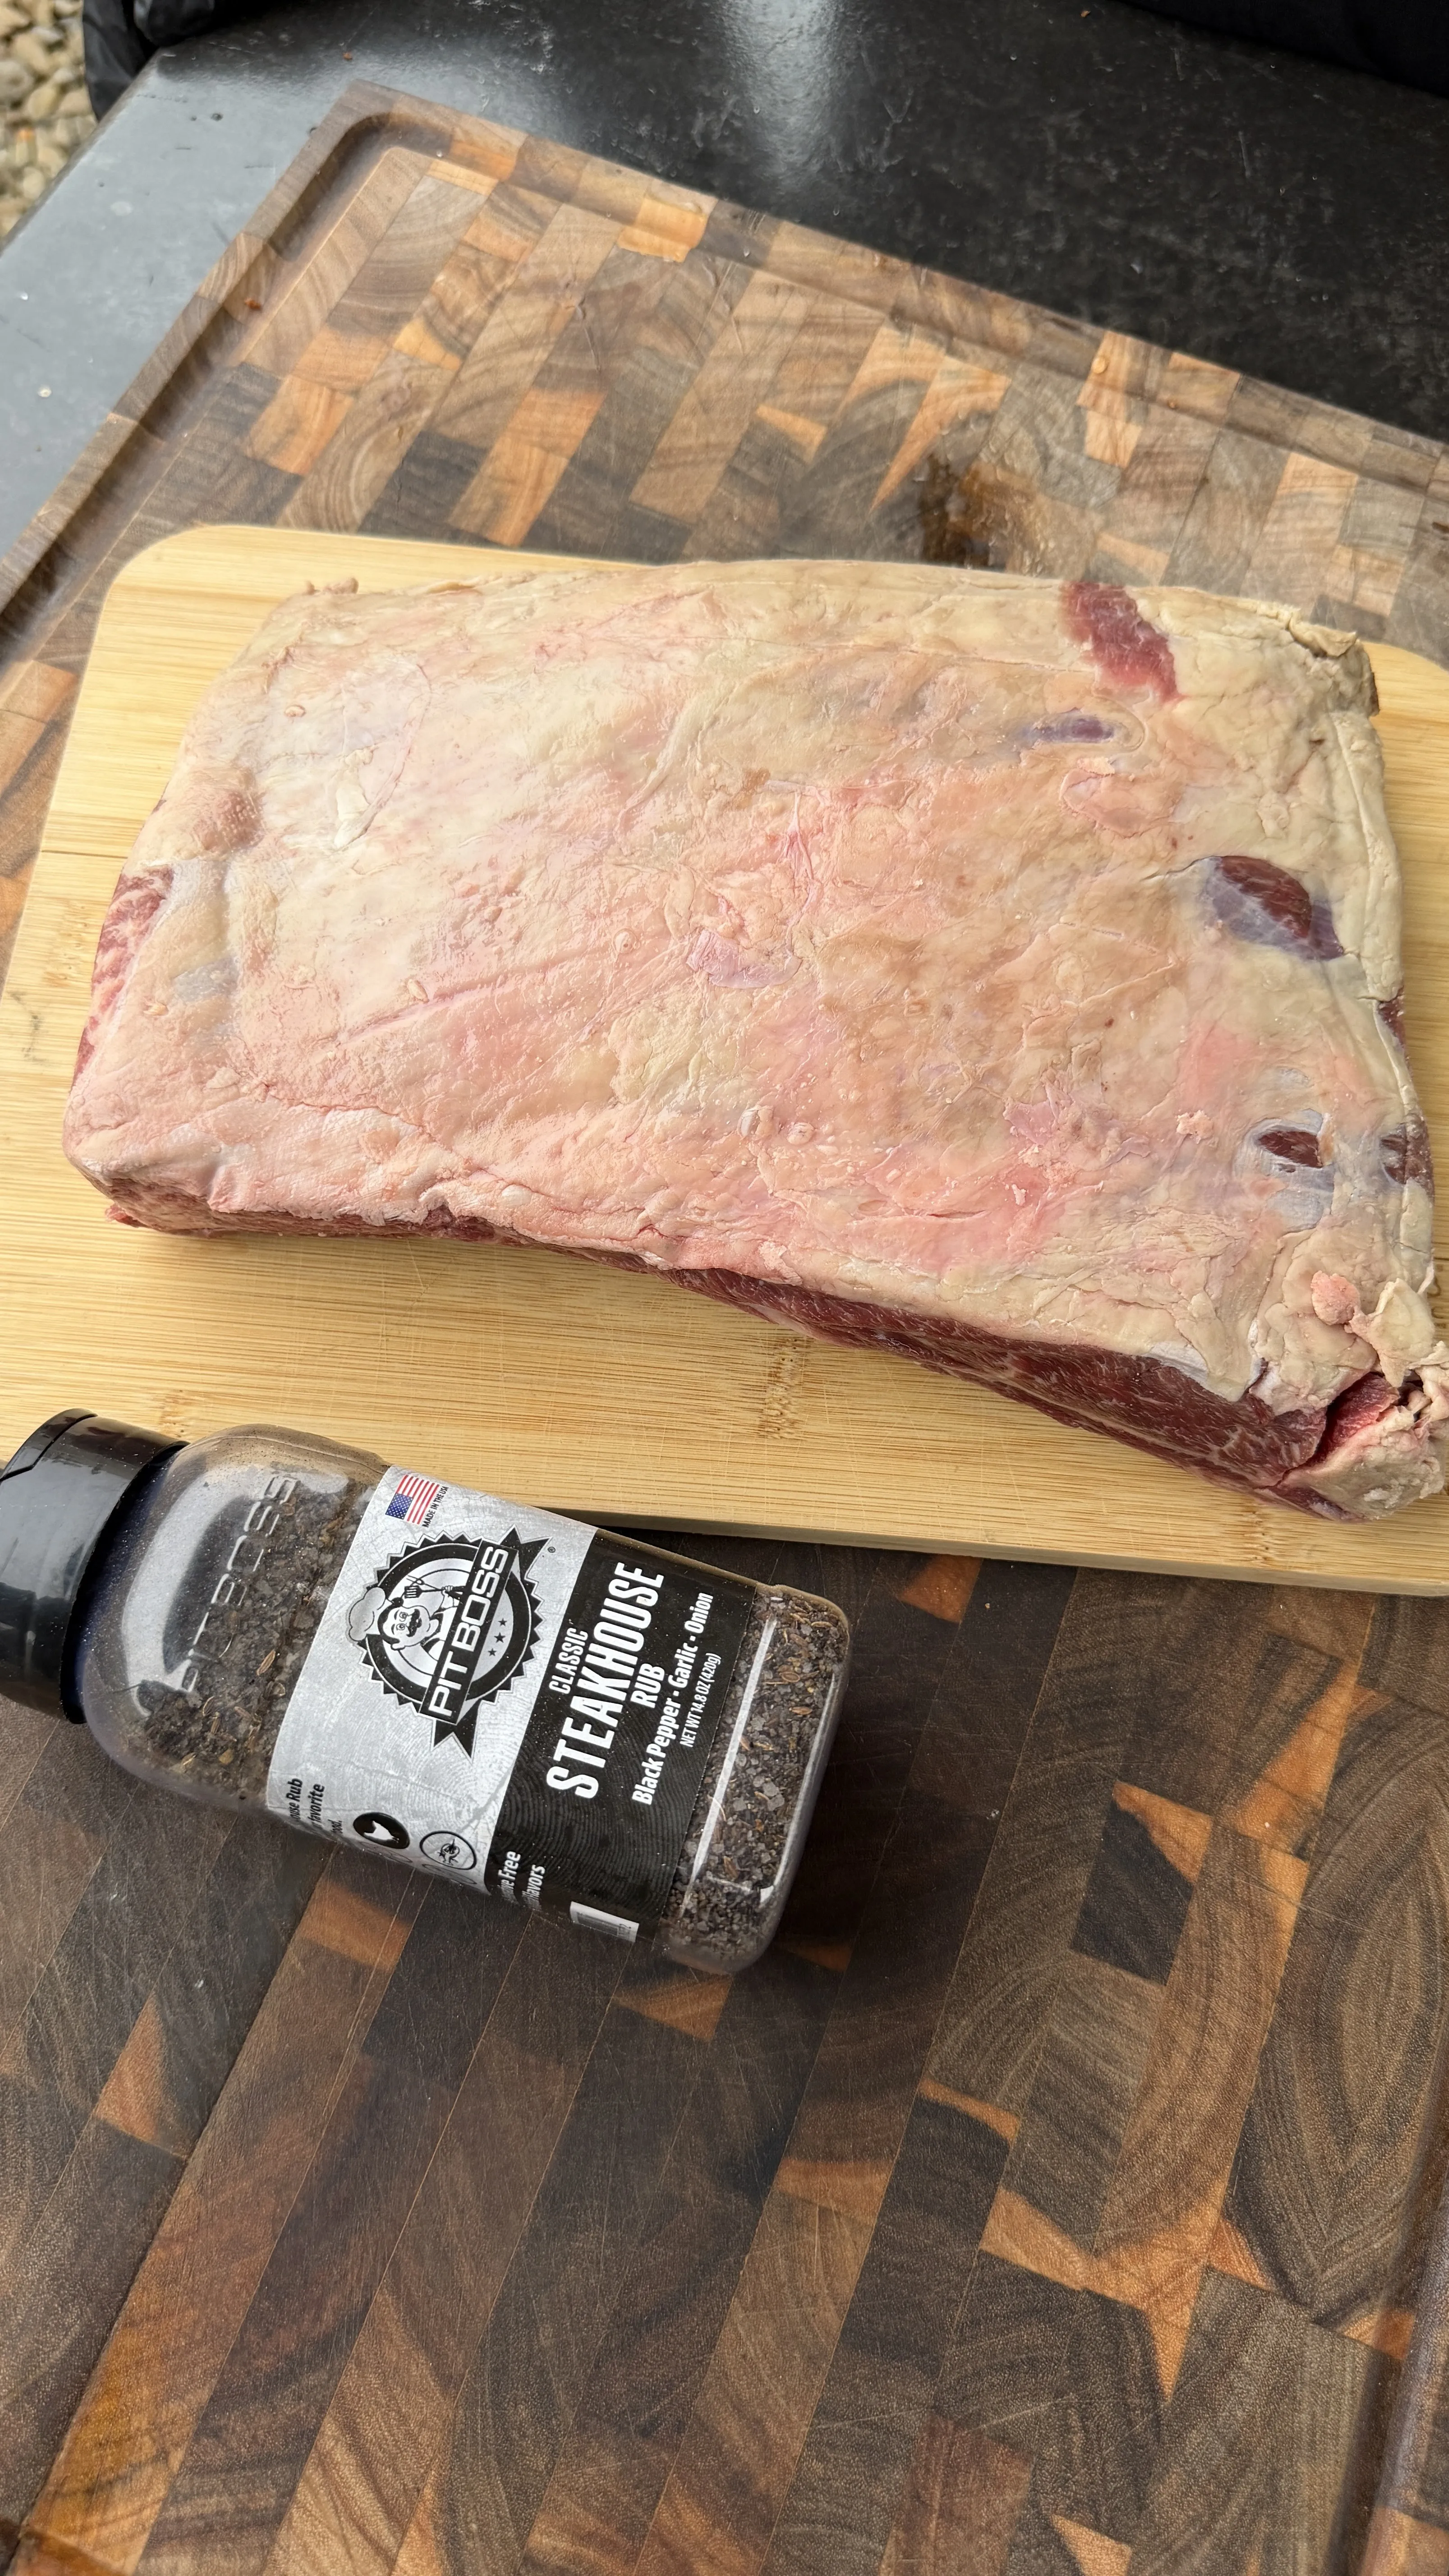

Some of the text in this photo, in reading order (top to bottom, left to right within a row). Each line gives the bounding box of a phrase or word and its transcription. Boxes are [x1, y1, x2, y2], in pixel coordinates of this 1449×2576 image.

[422, 1510, 435, 1528] MADE
[433, 1493, 444, 1503] THE
[440, 1486, 449, 1496] USA
[428, 1546, 509, 1717] PIT BOSS
[548, 1628, 588, 1694] CLASSIC
[546, 1562, 664, 1799] STEAKHOUSE
[630, 1663, 665, 1708] RUB
[632, 1592, 713, 1805] Black Pepper Garlic Onion
[680, 1653, 722, 1747] NET WT 14.8 OZ (420g)
[286, 1778, 303, 1802] Rub
[498, 1851, 521, 1880] Free
